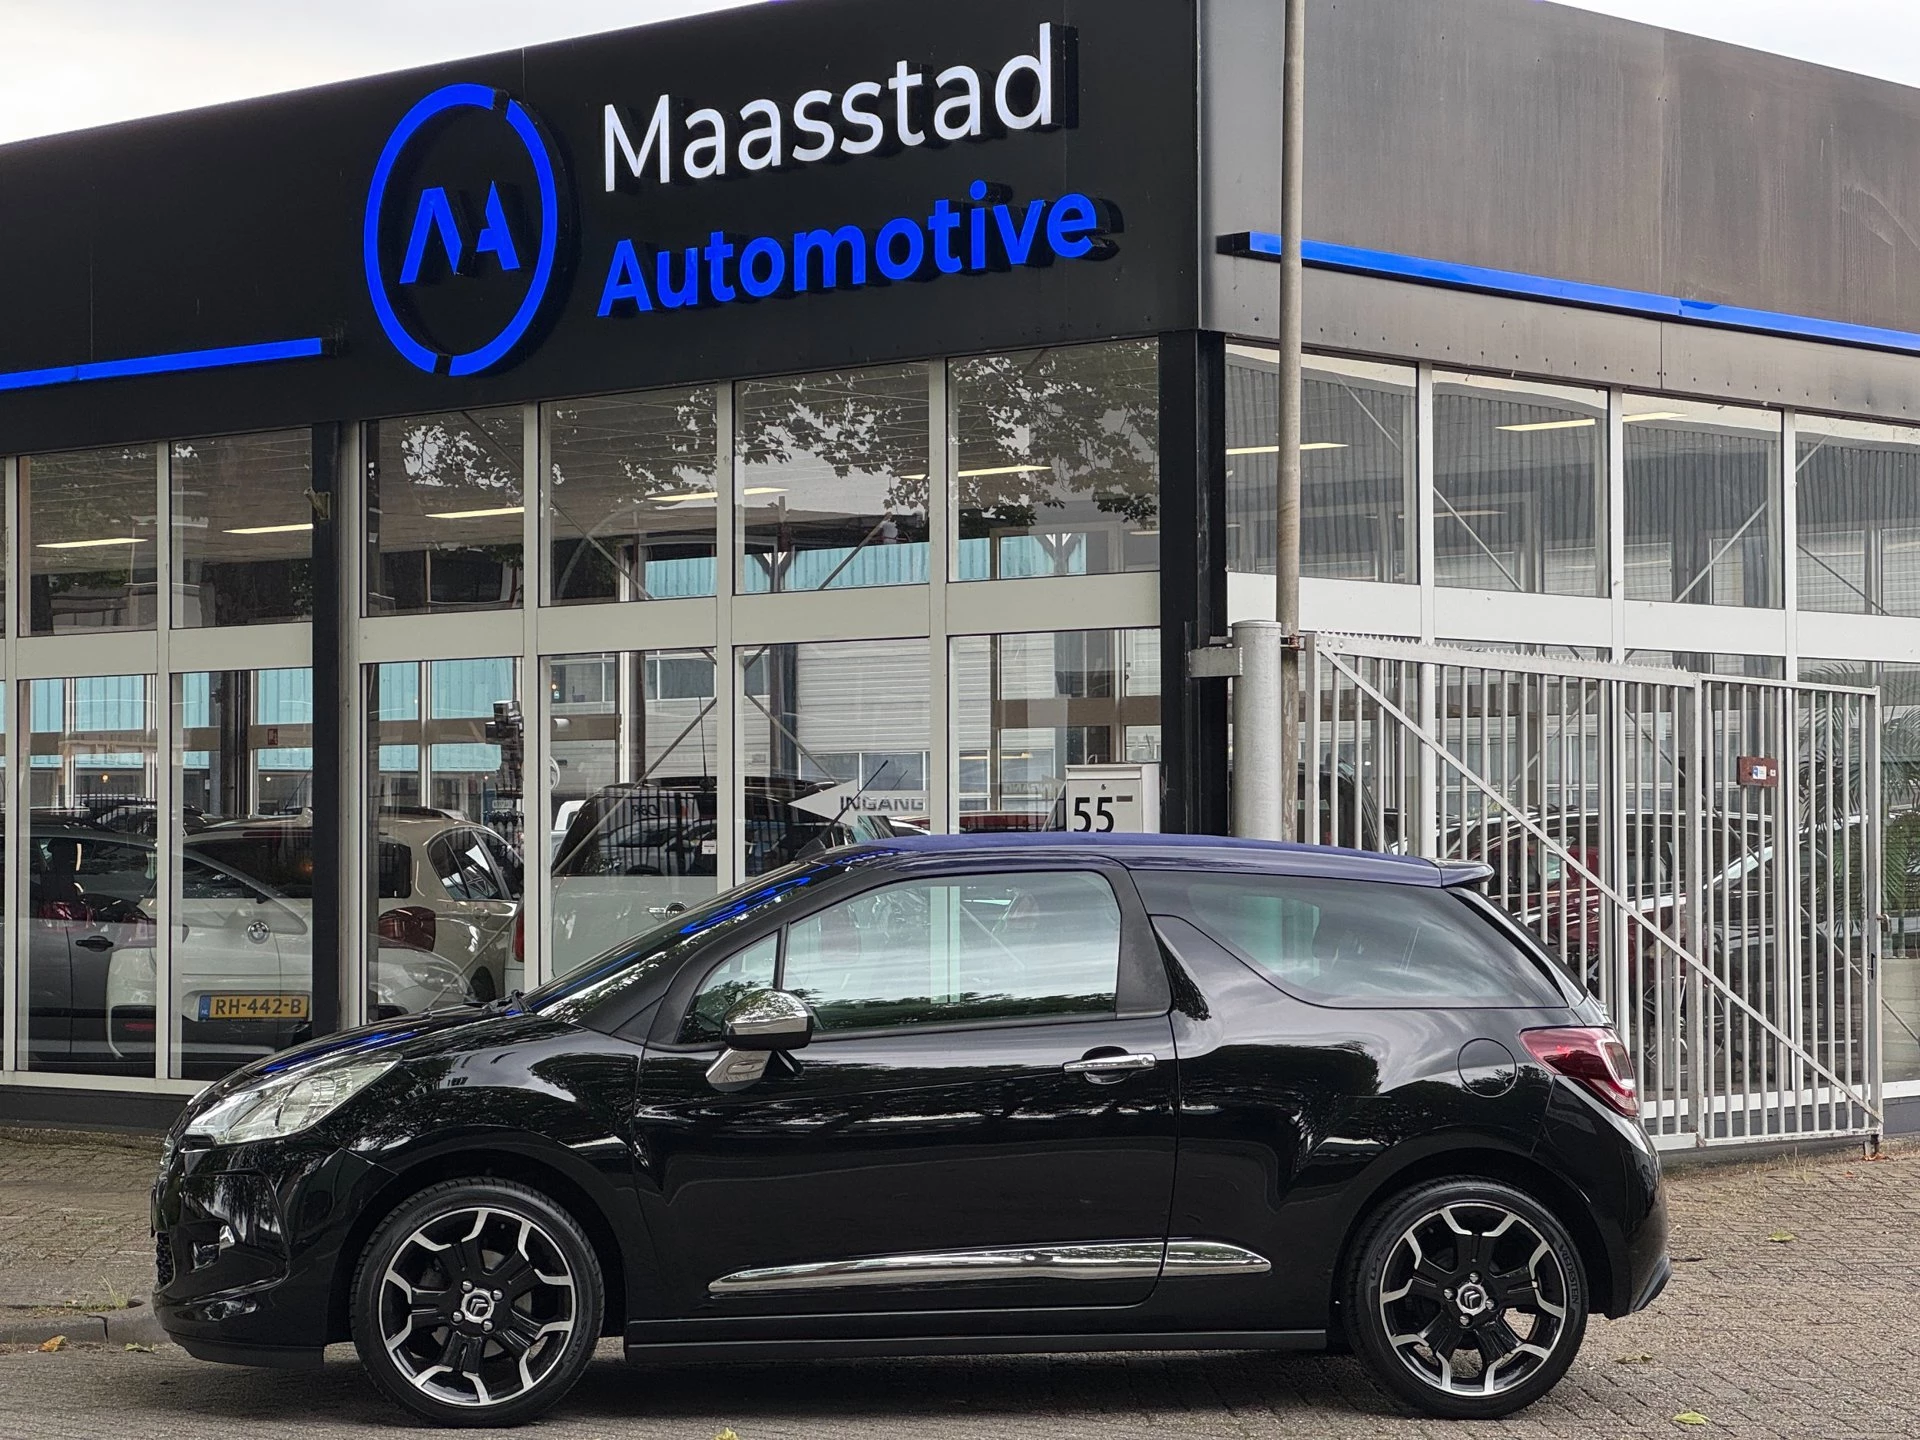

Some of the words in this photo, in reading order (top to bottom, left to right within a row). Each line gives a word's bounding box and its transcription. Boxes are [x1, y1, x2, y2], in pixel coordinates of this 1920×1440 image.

[605, 22, 1052, 193] Maasstad
[597, 179, 1098, 317] Automotive
[840, 795, 924, 812] INGANG
[1073, 796, 1115, 833] 55
[215, 998, 302, 1015] RH-442-B
